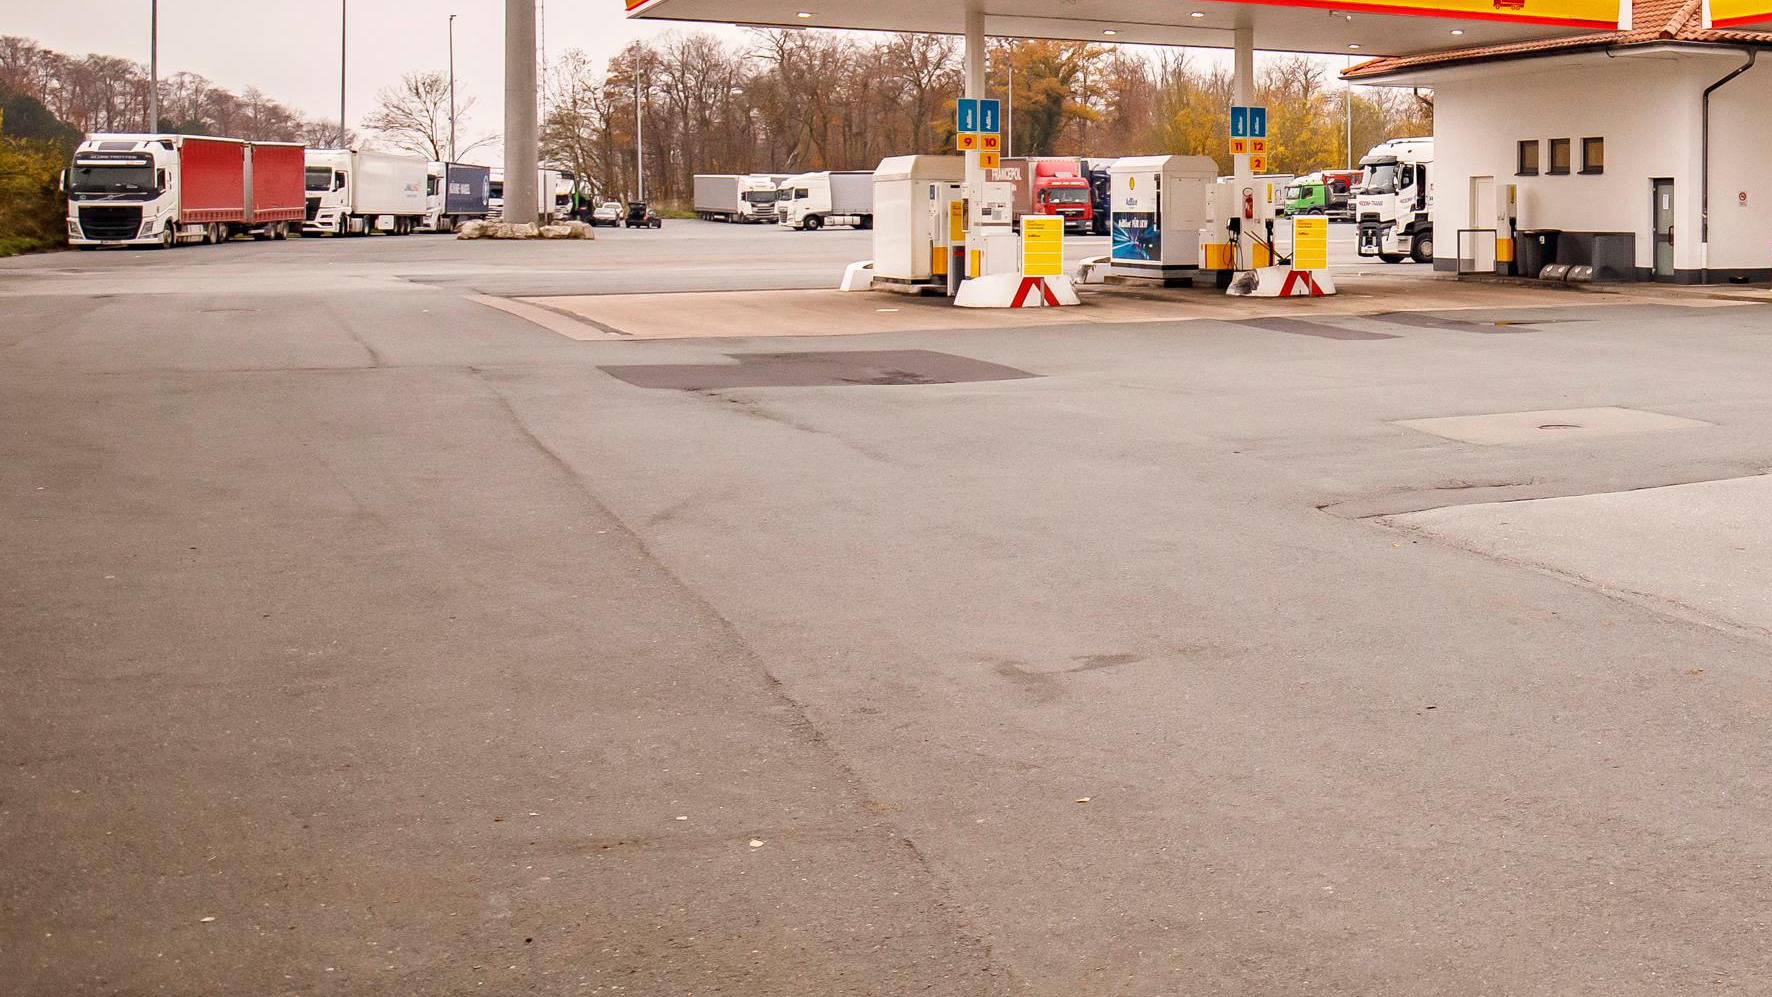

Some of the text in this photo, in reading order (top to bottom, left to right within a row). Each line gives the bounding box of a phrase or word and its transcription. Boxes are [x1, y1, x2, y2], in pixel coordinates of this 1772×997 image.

[963, 137, 973, 147] 9
[984, 138, 997, 148] 10
[1234, 142, 1243, 151] 11
[1253, 142, 1264, 151] 12
[987, 156, 991, 165] 1
[1254, 159, 1262, 168] 2
